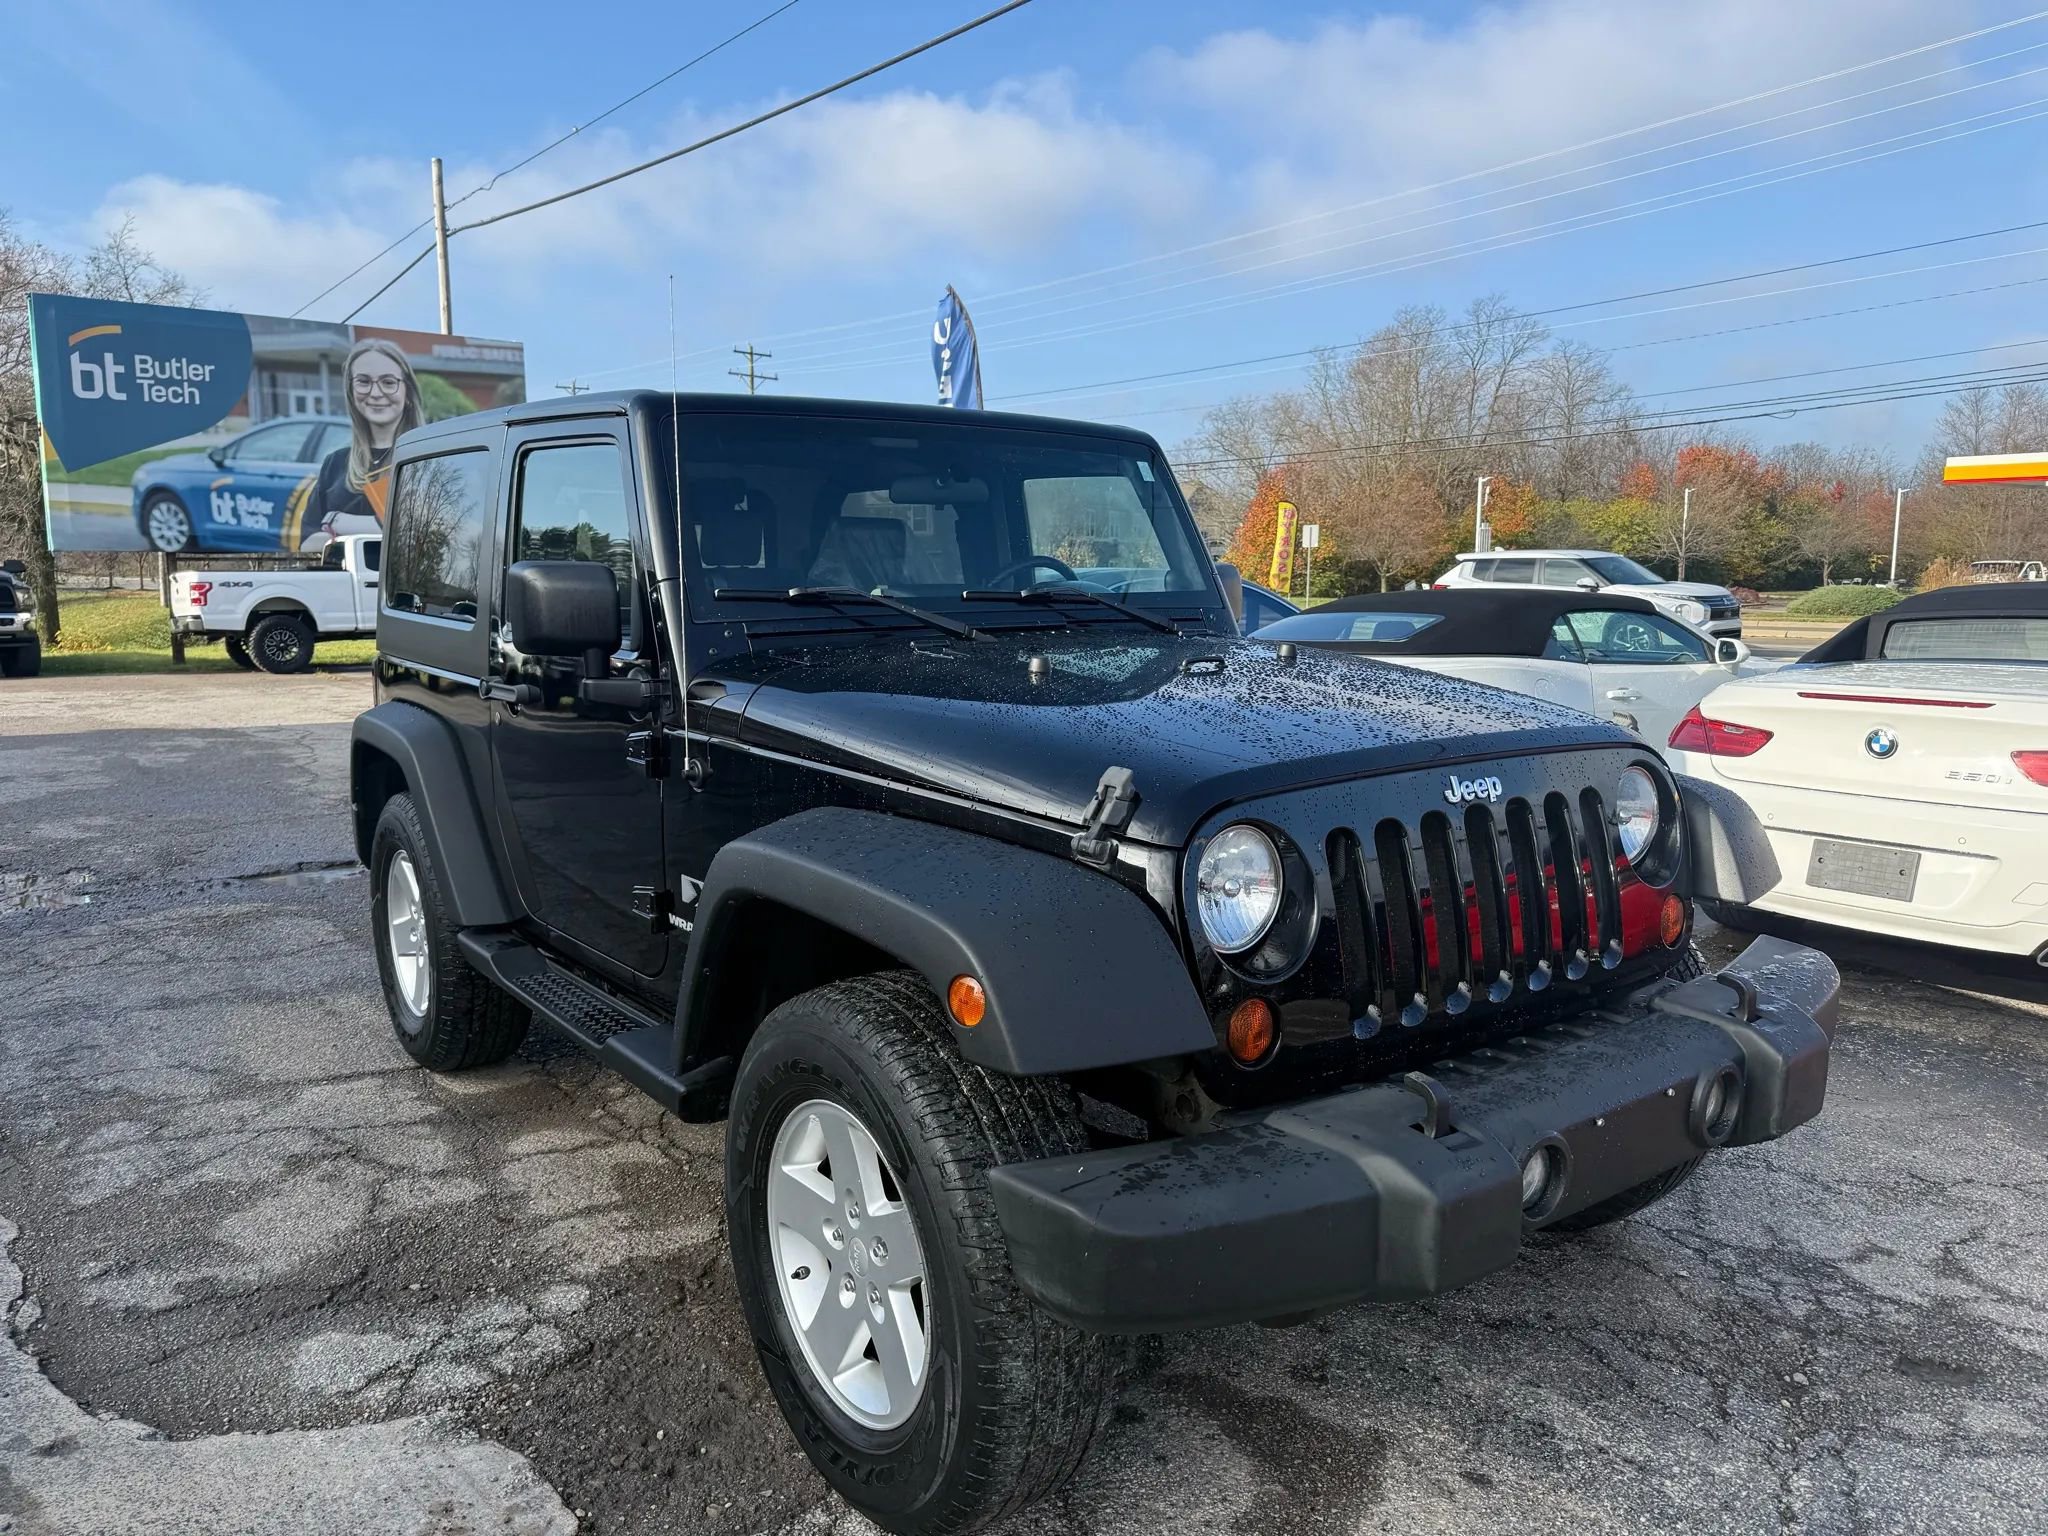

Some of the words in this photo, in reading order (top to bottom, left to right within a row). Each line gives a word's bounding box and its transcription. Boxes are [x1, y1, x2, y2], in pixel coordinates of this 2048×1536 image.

[70, 351, 127, 400] bt
[134, 354, 215, 382] Butler
[136, 379, 200, 405] Tech
[1444, 775, 1502, 803] Jeep
